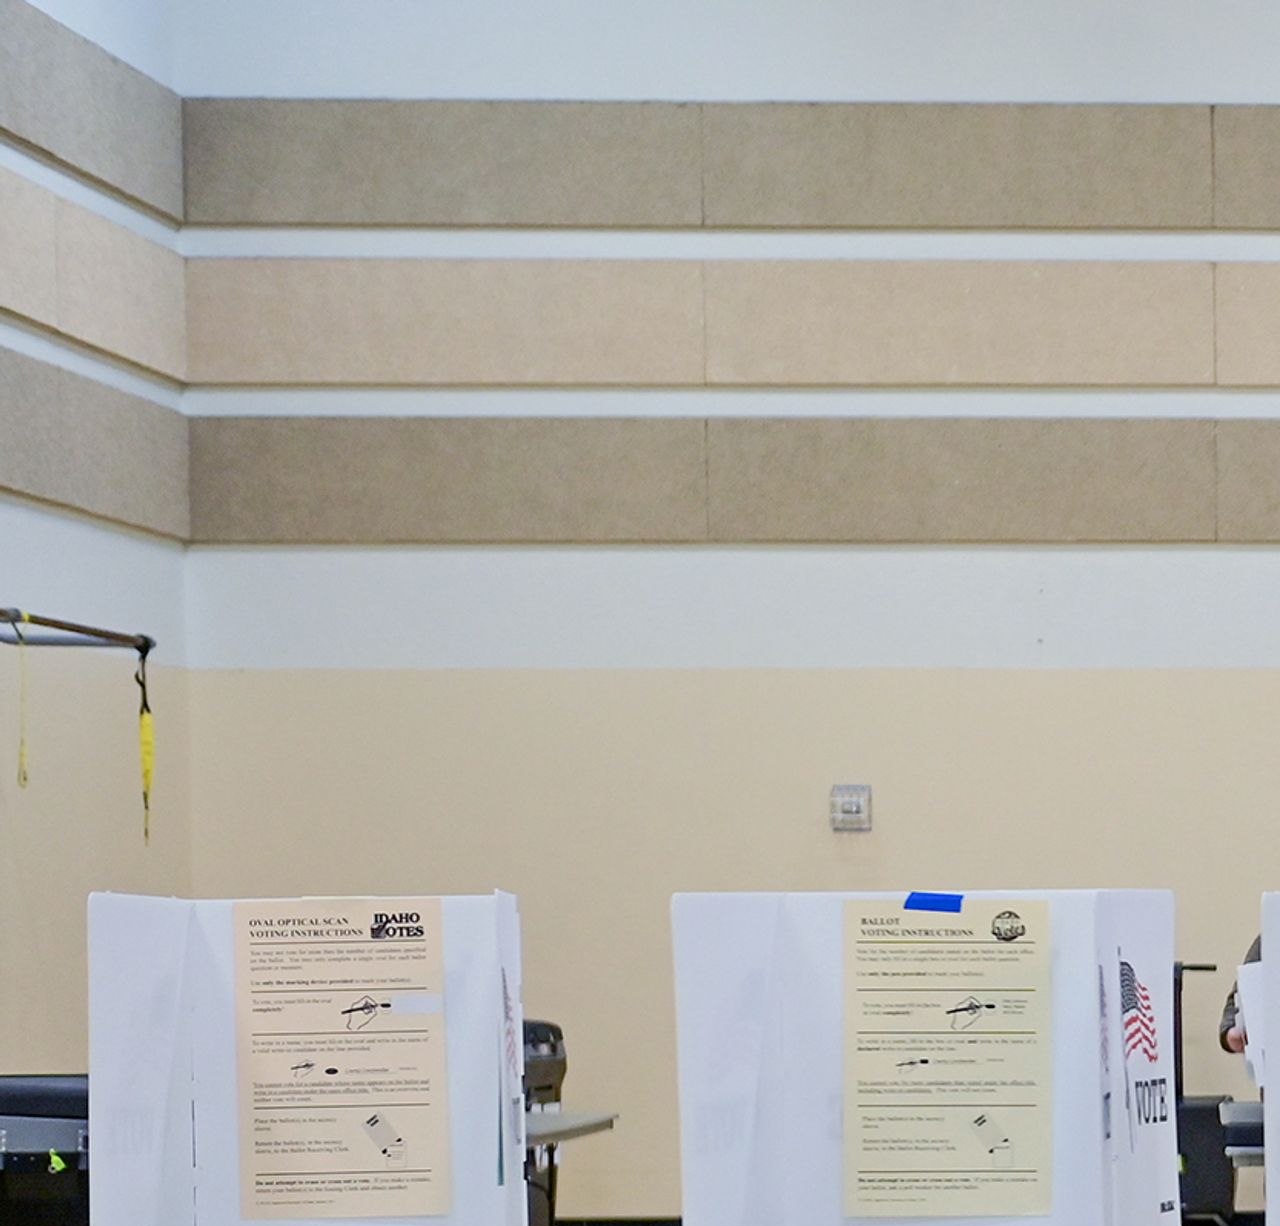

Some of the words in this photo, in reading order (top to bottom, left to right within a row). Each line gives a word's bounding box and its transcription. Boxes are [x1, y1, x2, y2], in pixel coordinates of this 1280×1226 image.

[249, 918, 275, 928] OVAL
[276, 917, 320, 927] OPTICAL
[322, 917, 350, 926] SCAN
[374, 912, 421, 925] IDAHO
[860, 917, 900, 926] BALLOT
[249, 929, 289, 939] VOTING
[290, 928, 364, 938] INSTRUCTIONS
[860, 928, 900, 937] VOTING
[901, 928, 974, 937] INSTRUCTIONS
[1135, 1078, 1168, 1125] VOTE
